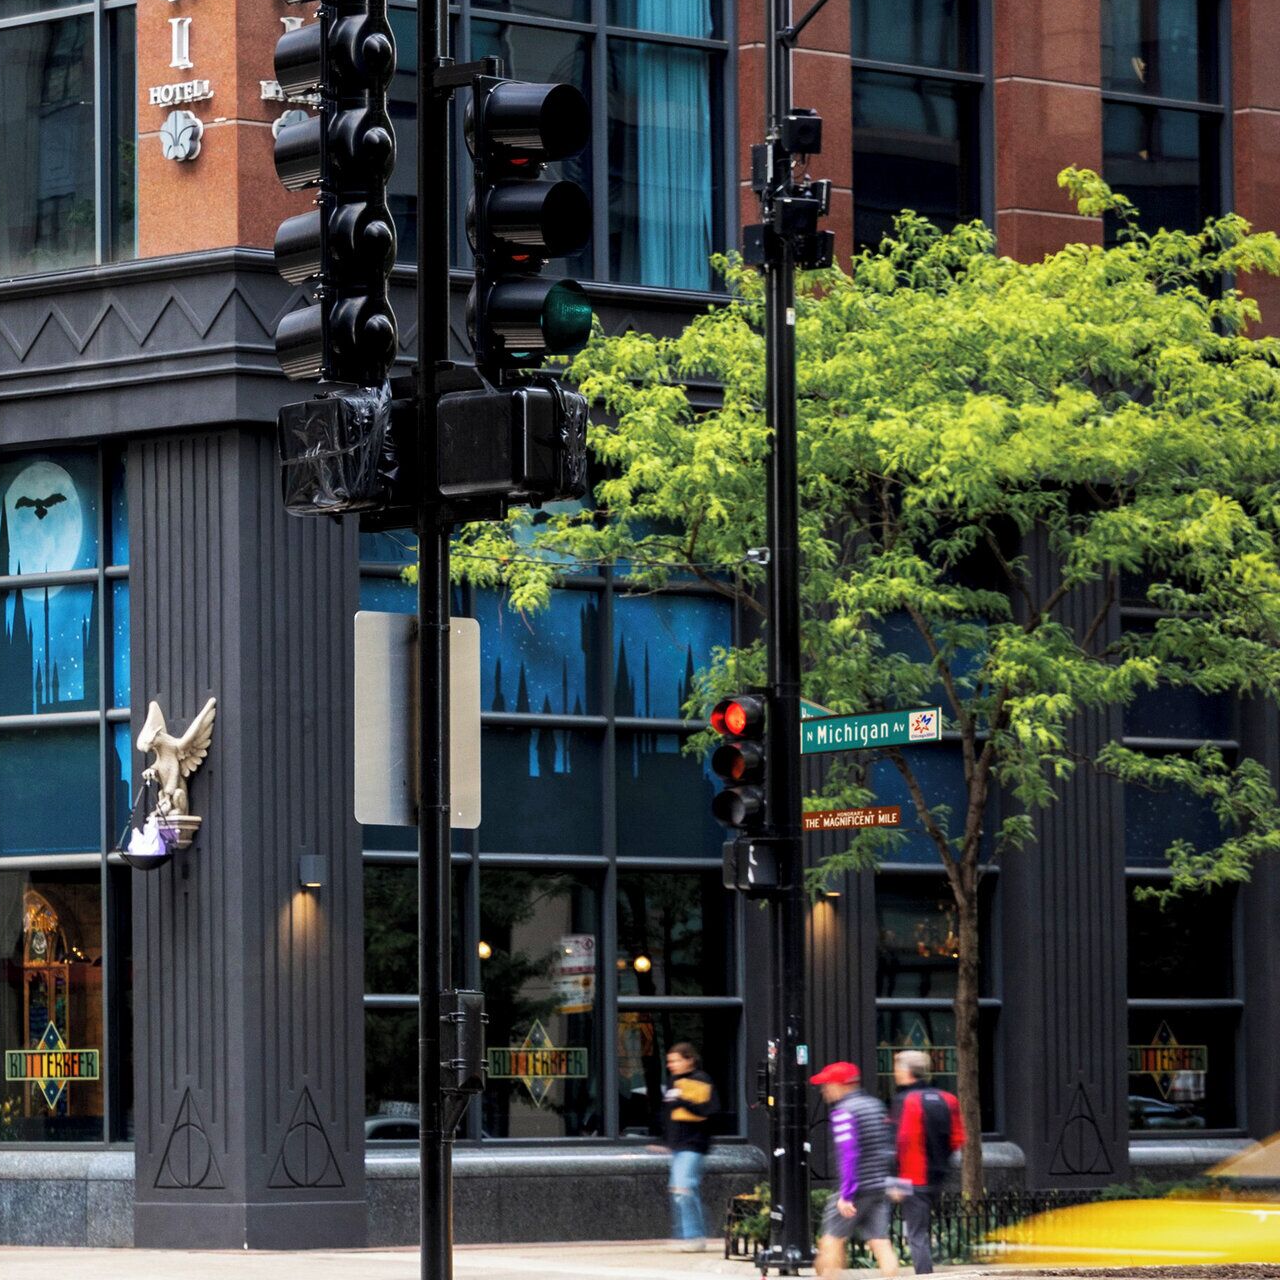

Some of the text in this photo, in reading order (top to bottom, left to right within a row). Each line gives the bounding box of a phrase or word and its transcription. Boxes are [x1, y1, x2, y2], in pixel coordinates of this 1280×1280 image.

[148, 80, 214, 107] HOTEL
[806, 722, 905, 746] N Michigan Av
[805, 812, 898, 829] THE MAGNIFICENT MILE
[8, 1052, 97, 1078] BUTTERBEER
[490, 1049, 586, 1076] BUTTERBEER
